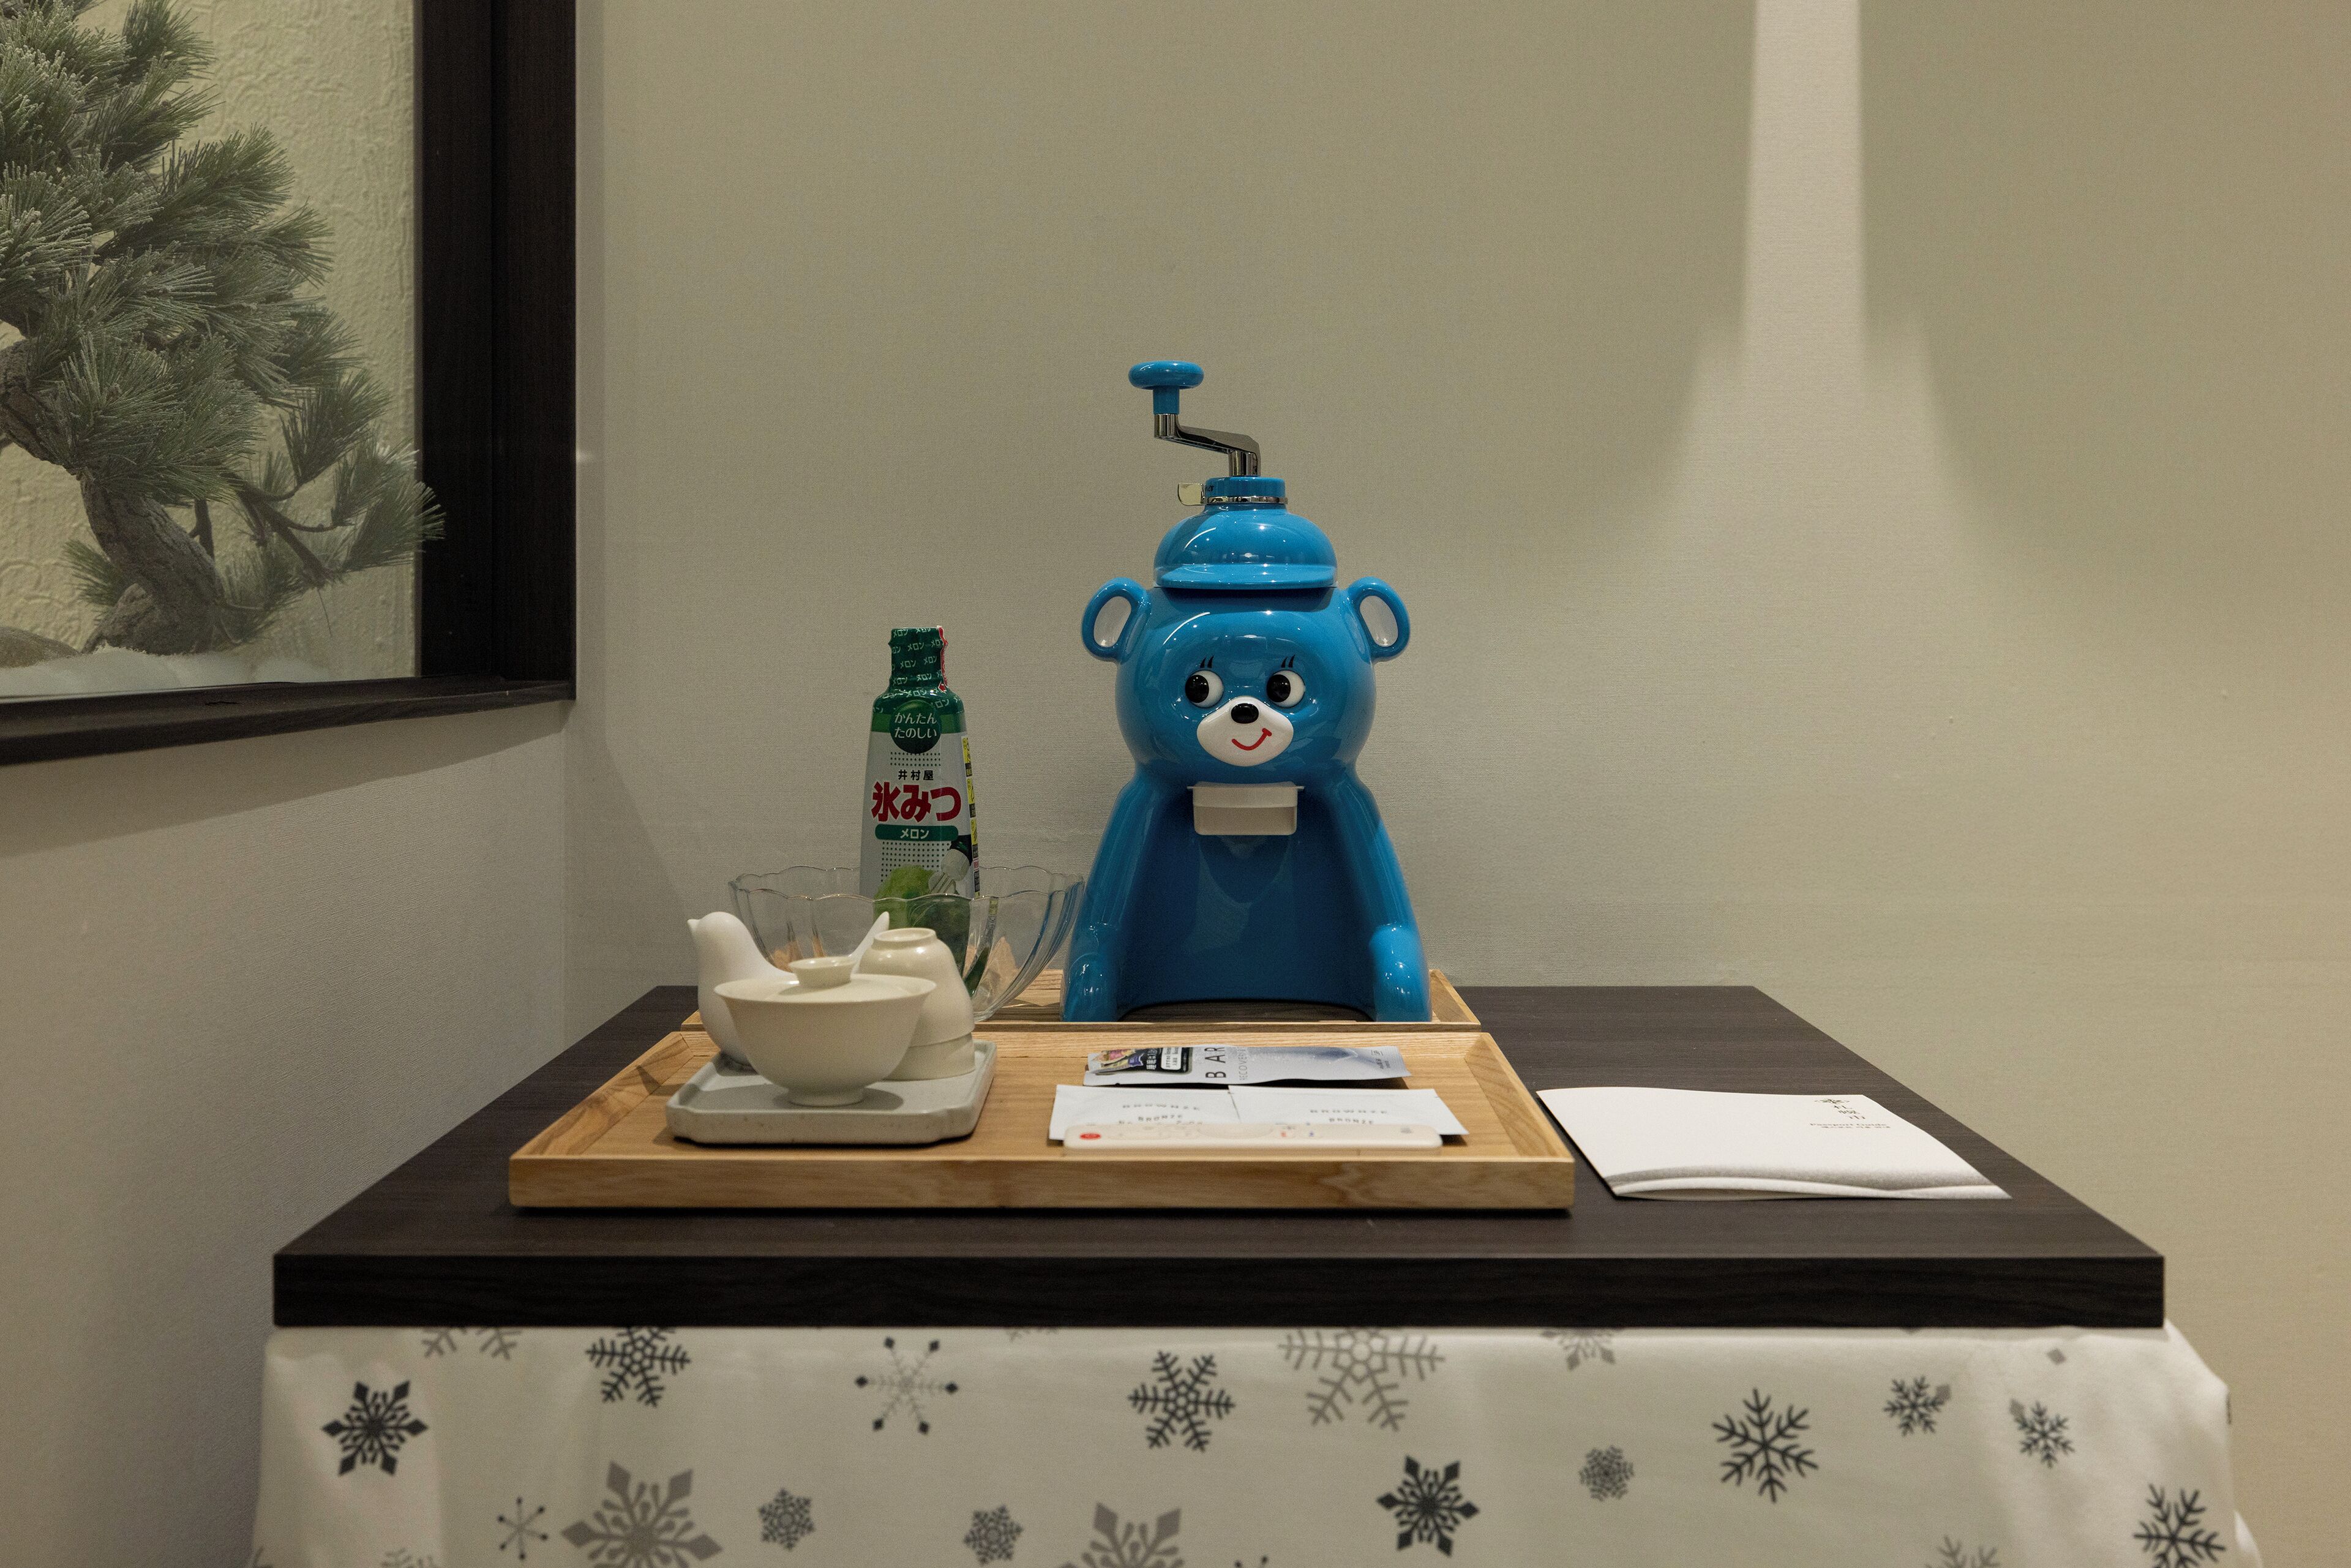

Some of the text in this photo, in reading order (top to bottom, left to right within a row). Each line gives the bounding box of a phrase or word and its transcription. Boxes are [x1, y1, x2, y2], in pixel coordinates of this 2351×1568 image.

[893, 628, 909, 638] メロン
[891, 645, 901, 655] ロン
[907, 642, 924, 651] メロン
[900, 659, 917, 669] メロン
[924, 655, 937, 665] メロン
[893, 676, 908, 686] メロン
[906, 689, 927, 697] メロン
[894, 712, 937, 724] かんたん
[894, 727, 937, 738] たのしい
[898, 769, 934, 781] 井村屋
[871, 781, 962, 823] 氷みつ
[900, 828, 929, 839] メロン
